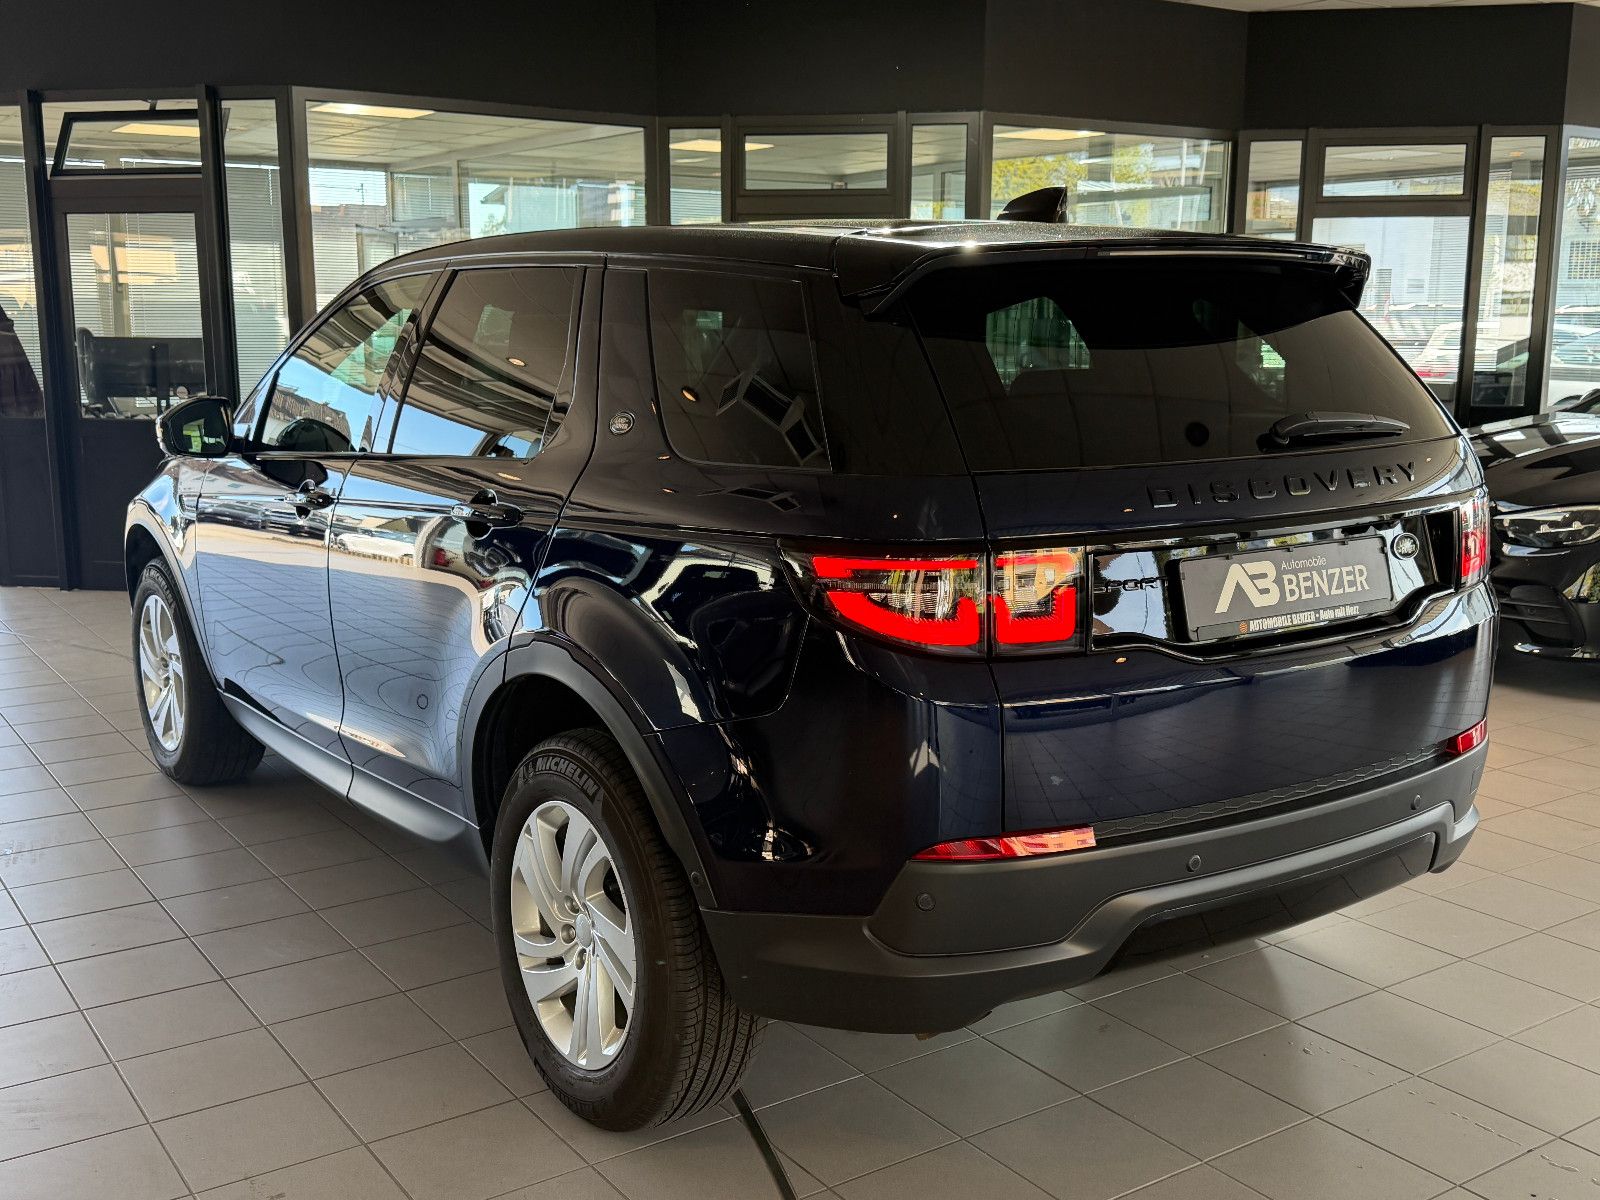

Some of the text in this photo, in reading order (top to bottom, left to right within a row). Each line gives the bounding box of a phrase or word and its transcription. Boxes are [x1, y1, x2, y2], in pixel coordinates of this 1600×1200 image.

[1146, 461, 1415, 508] DISCOVERY
[1281, 556, 1327, 570] Automobile
[1214, 560, 1280, 614] AB
[1283, 565, 1370, 602] BENZER
[1249, 614, 1293, 632] AUTOMOBILE
[1292, 611, 1316, 625] BENZER
[1320, 609, 1335, 620] Auto
[1334, 606, 1346, 618] mit
[536, 757, 599, 796] MICHELIN
